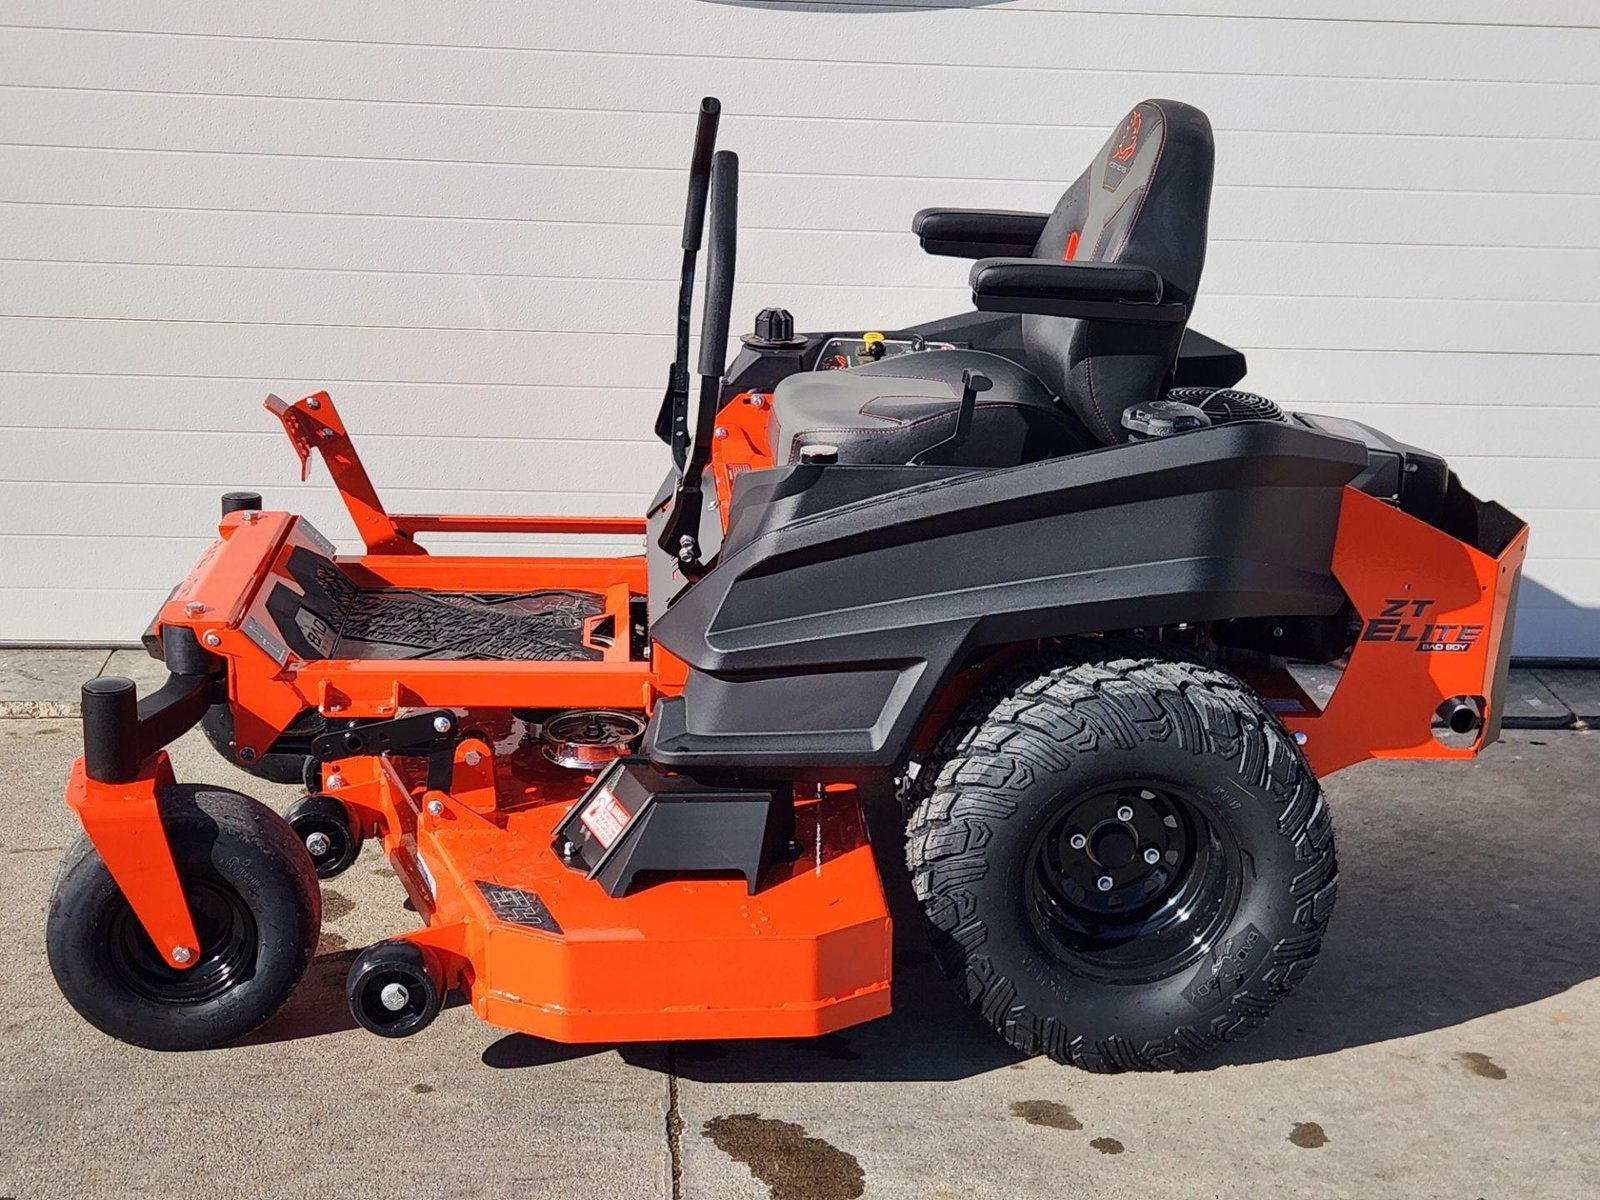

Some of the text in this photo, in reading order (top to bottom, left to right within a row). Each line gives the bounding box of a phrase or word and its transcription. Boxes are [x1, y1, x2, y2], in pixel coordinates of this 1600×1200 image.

[1380, 600, 1435, 617] ZT
[307, 618, 327, 648] BAD
[1361, 619, 1484, 642] ELITE
[1422, 643, 1468, 651] BAD BOY
[1235, 931, 1260, 962] BAD
